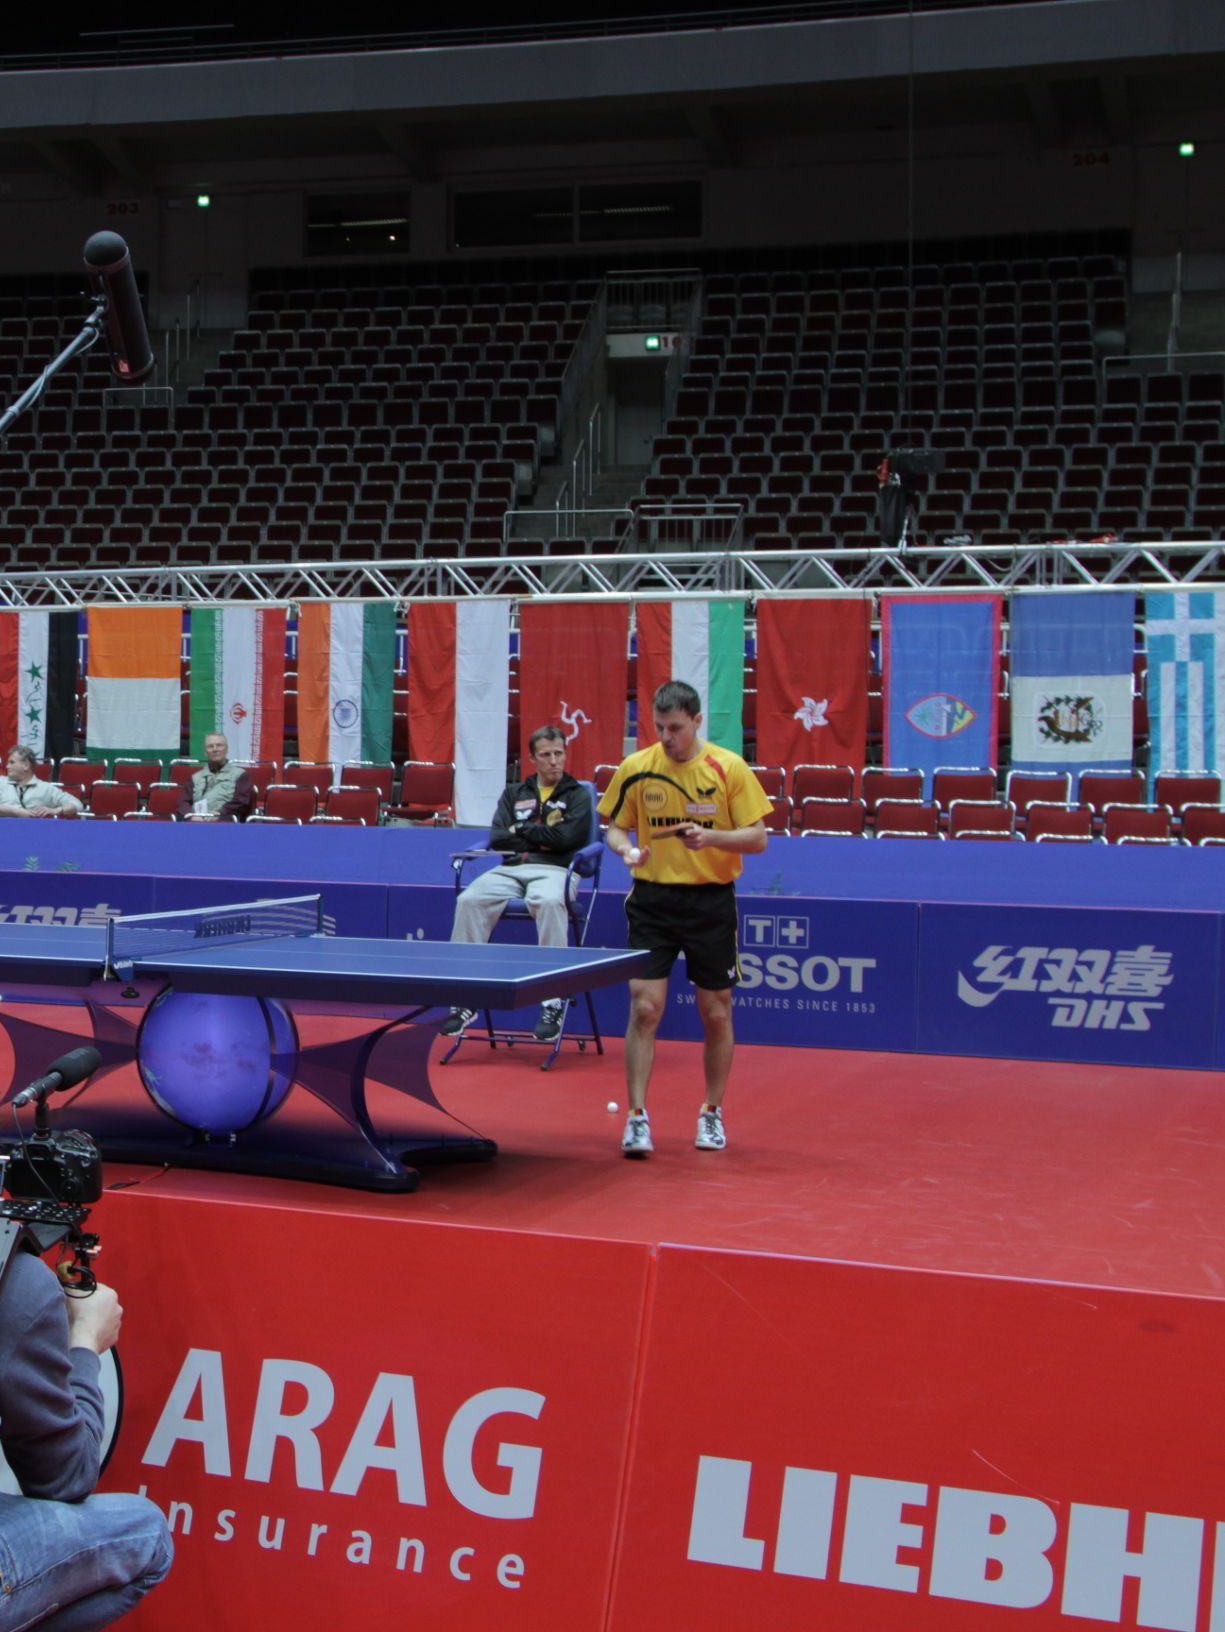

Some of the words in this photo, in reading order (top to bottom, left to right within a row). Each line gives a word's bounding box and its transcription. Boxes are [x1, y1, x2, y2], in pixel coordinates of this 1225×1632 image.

[797, 1000, 838, 1012] SINCE
[846, 1002, 876, 1013] 1853
[958, 945, 1174, 1007] 红双喜
[1047, 997, 1165, 1031] DHS
[141, 1348, 546, 1519] ARAG
[687, 1455, 1225, 1632] LIEBH
